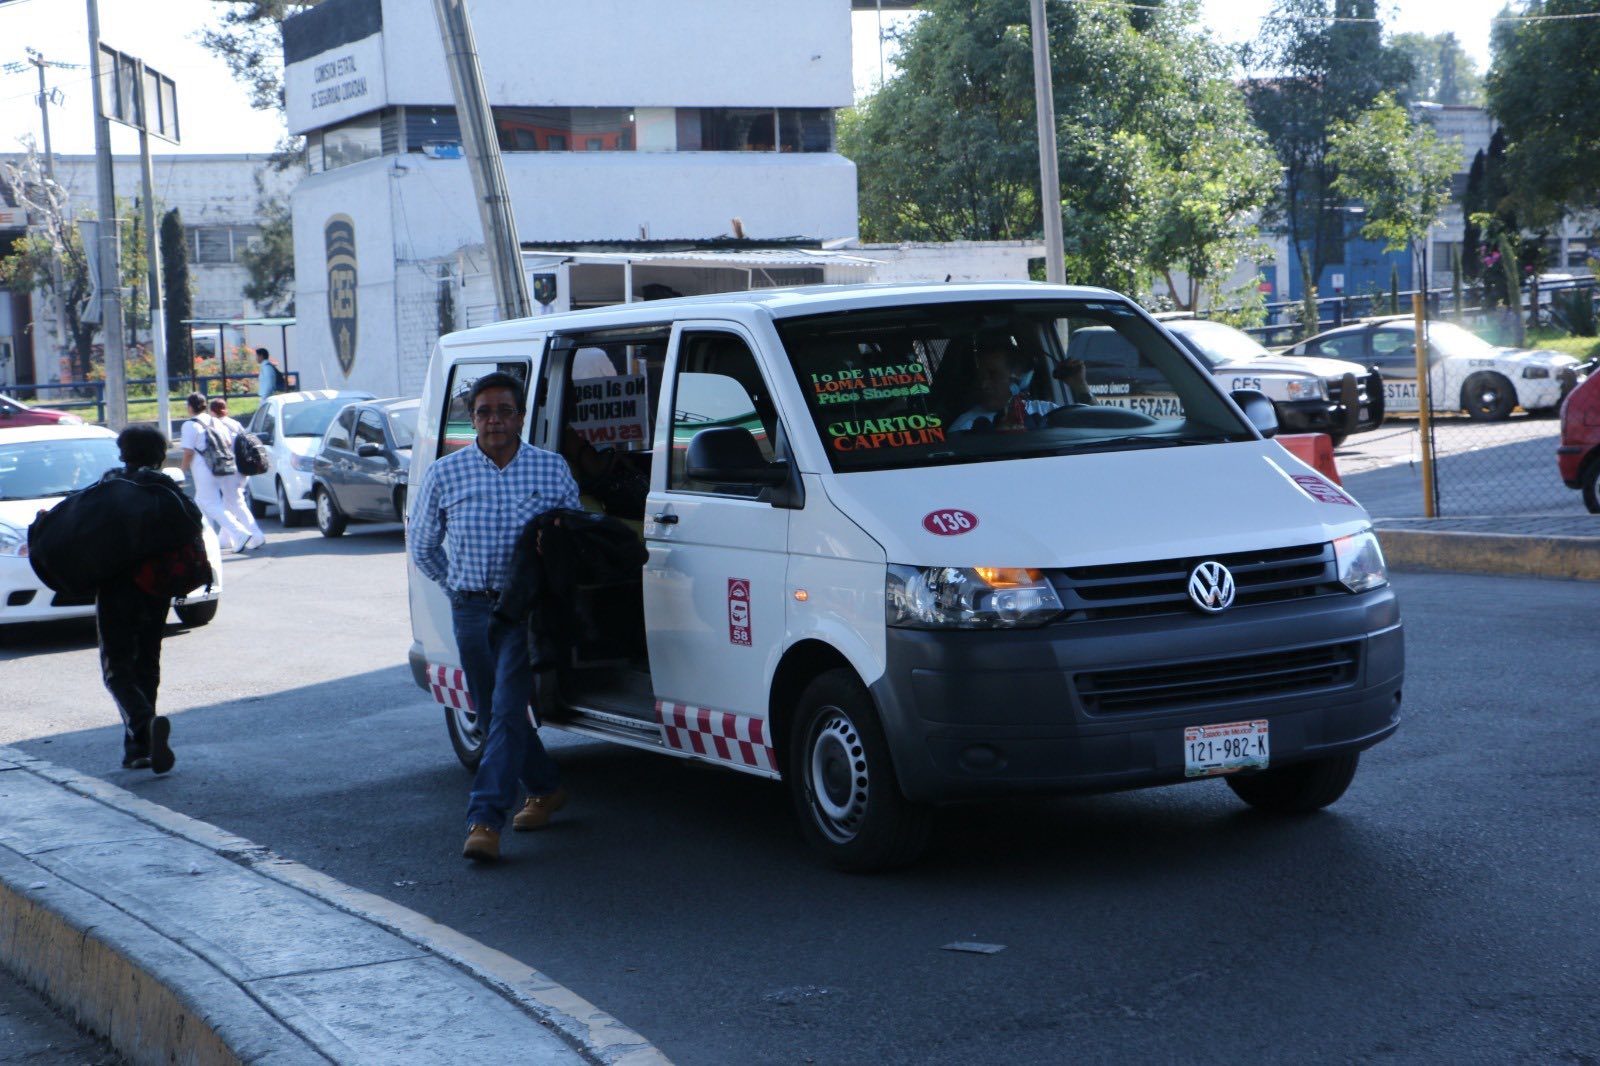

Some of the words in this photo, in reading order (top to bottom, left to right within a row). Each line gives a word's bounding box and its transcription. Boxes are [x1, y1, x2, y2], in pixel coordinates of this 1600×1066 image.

[838, 368, 864, 380] DE
[869, 363, 923, 377] MAYO
[814, 379, 866, 393] LOMA
[870, 373, 926, 387] LINDA
[1232, 377, 1261, 391] CES
[818, 391, 860, 404] Price
[862, 387, 910, 400] Shoes
[828, 414, 942, 437] CUARTOS
[833, 428, 945, 452] CAPULIN
[933, 511, 971, 533] 136
[733, 630, 748, 641] 58
[1190, 734, 1266, 762] 121-982-K
